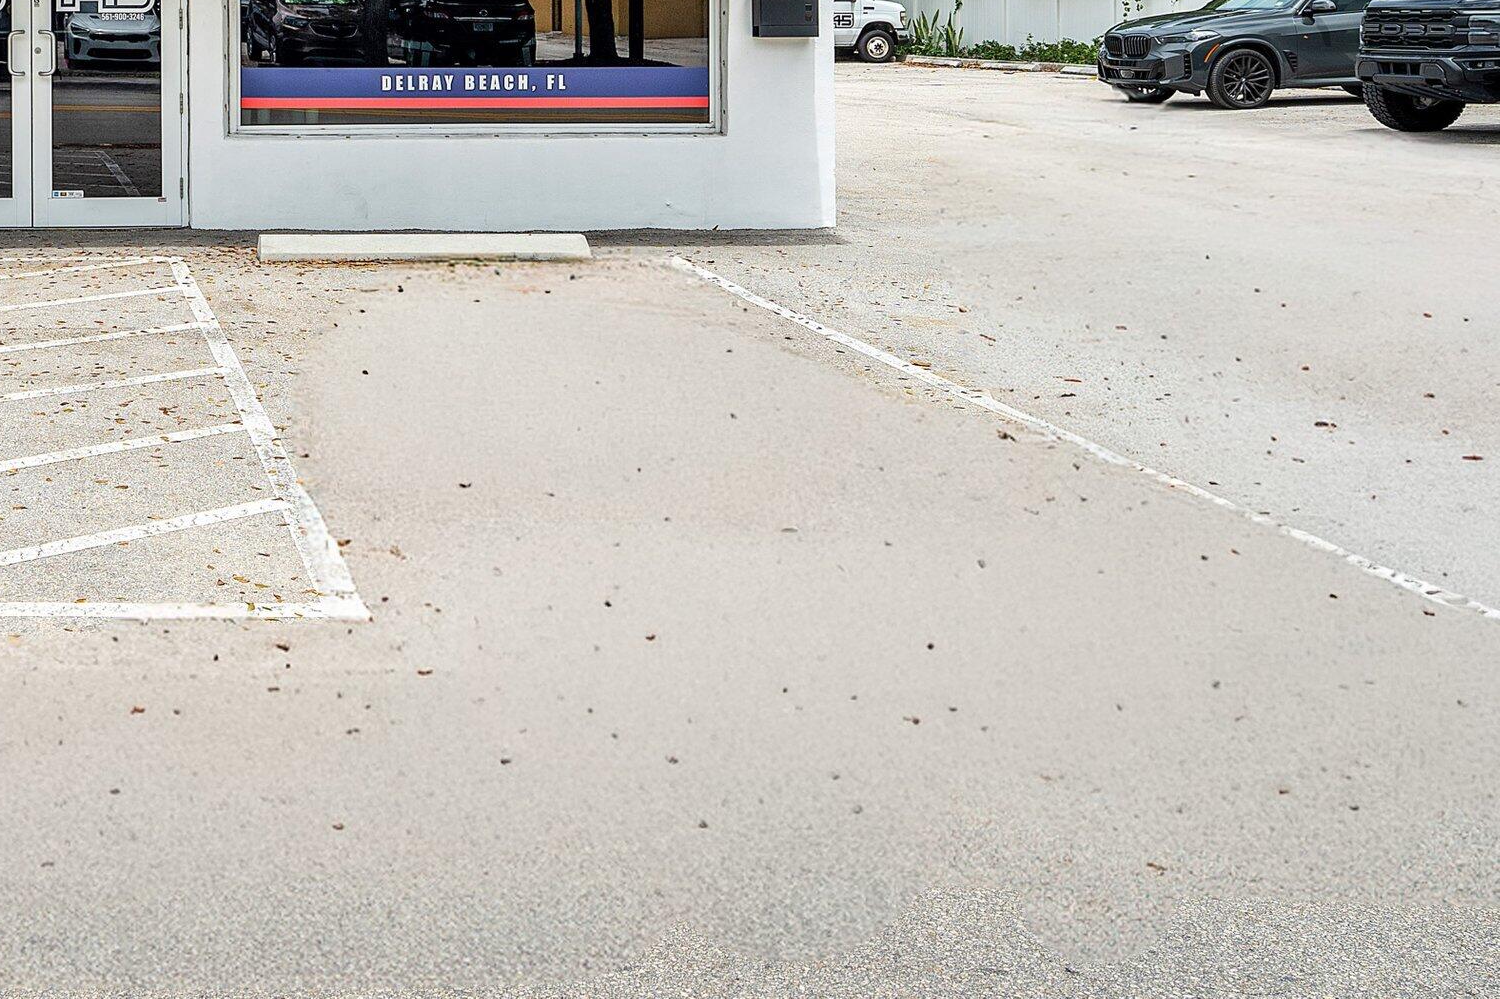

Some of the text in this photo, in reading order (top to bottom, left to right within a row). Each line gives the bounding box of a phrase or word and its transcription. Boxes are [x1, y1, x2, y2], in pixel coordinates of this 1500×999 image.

[101, 13, 145, 21] 561-900-3246
[833, 14, 852, 26] 45
[381, 74, 567, 92] DELRAY BEACH, FL
